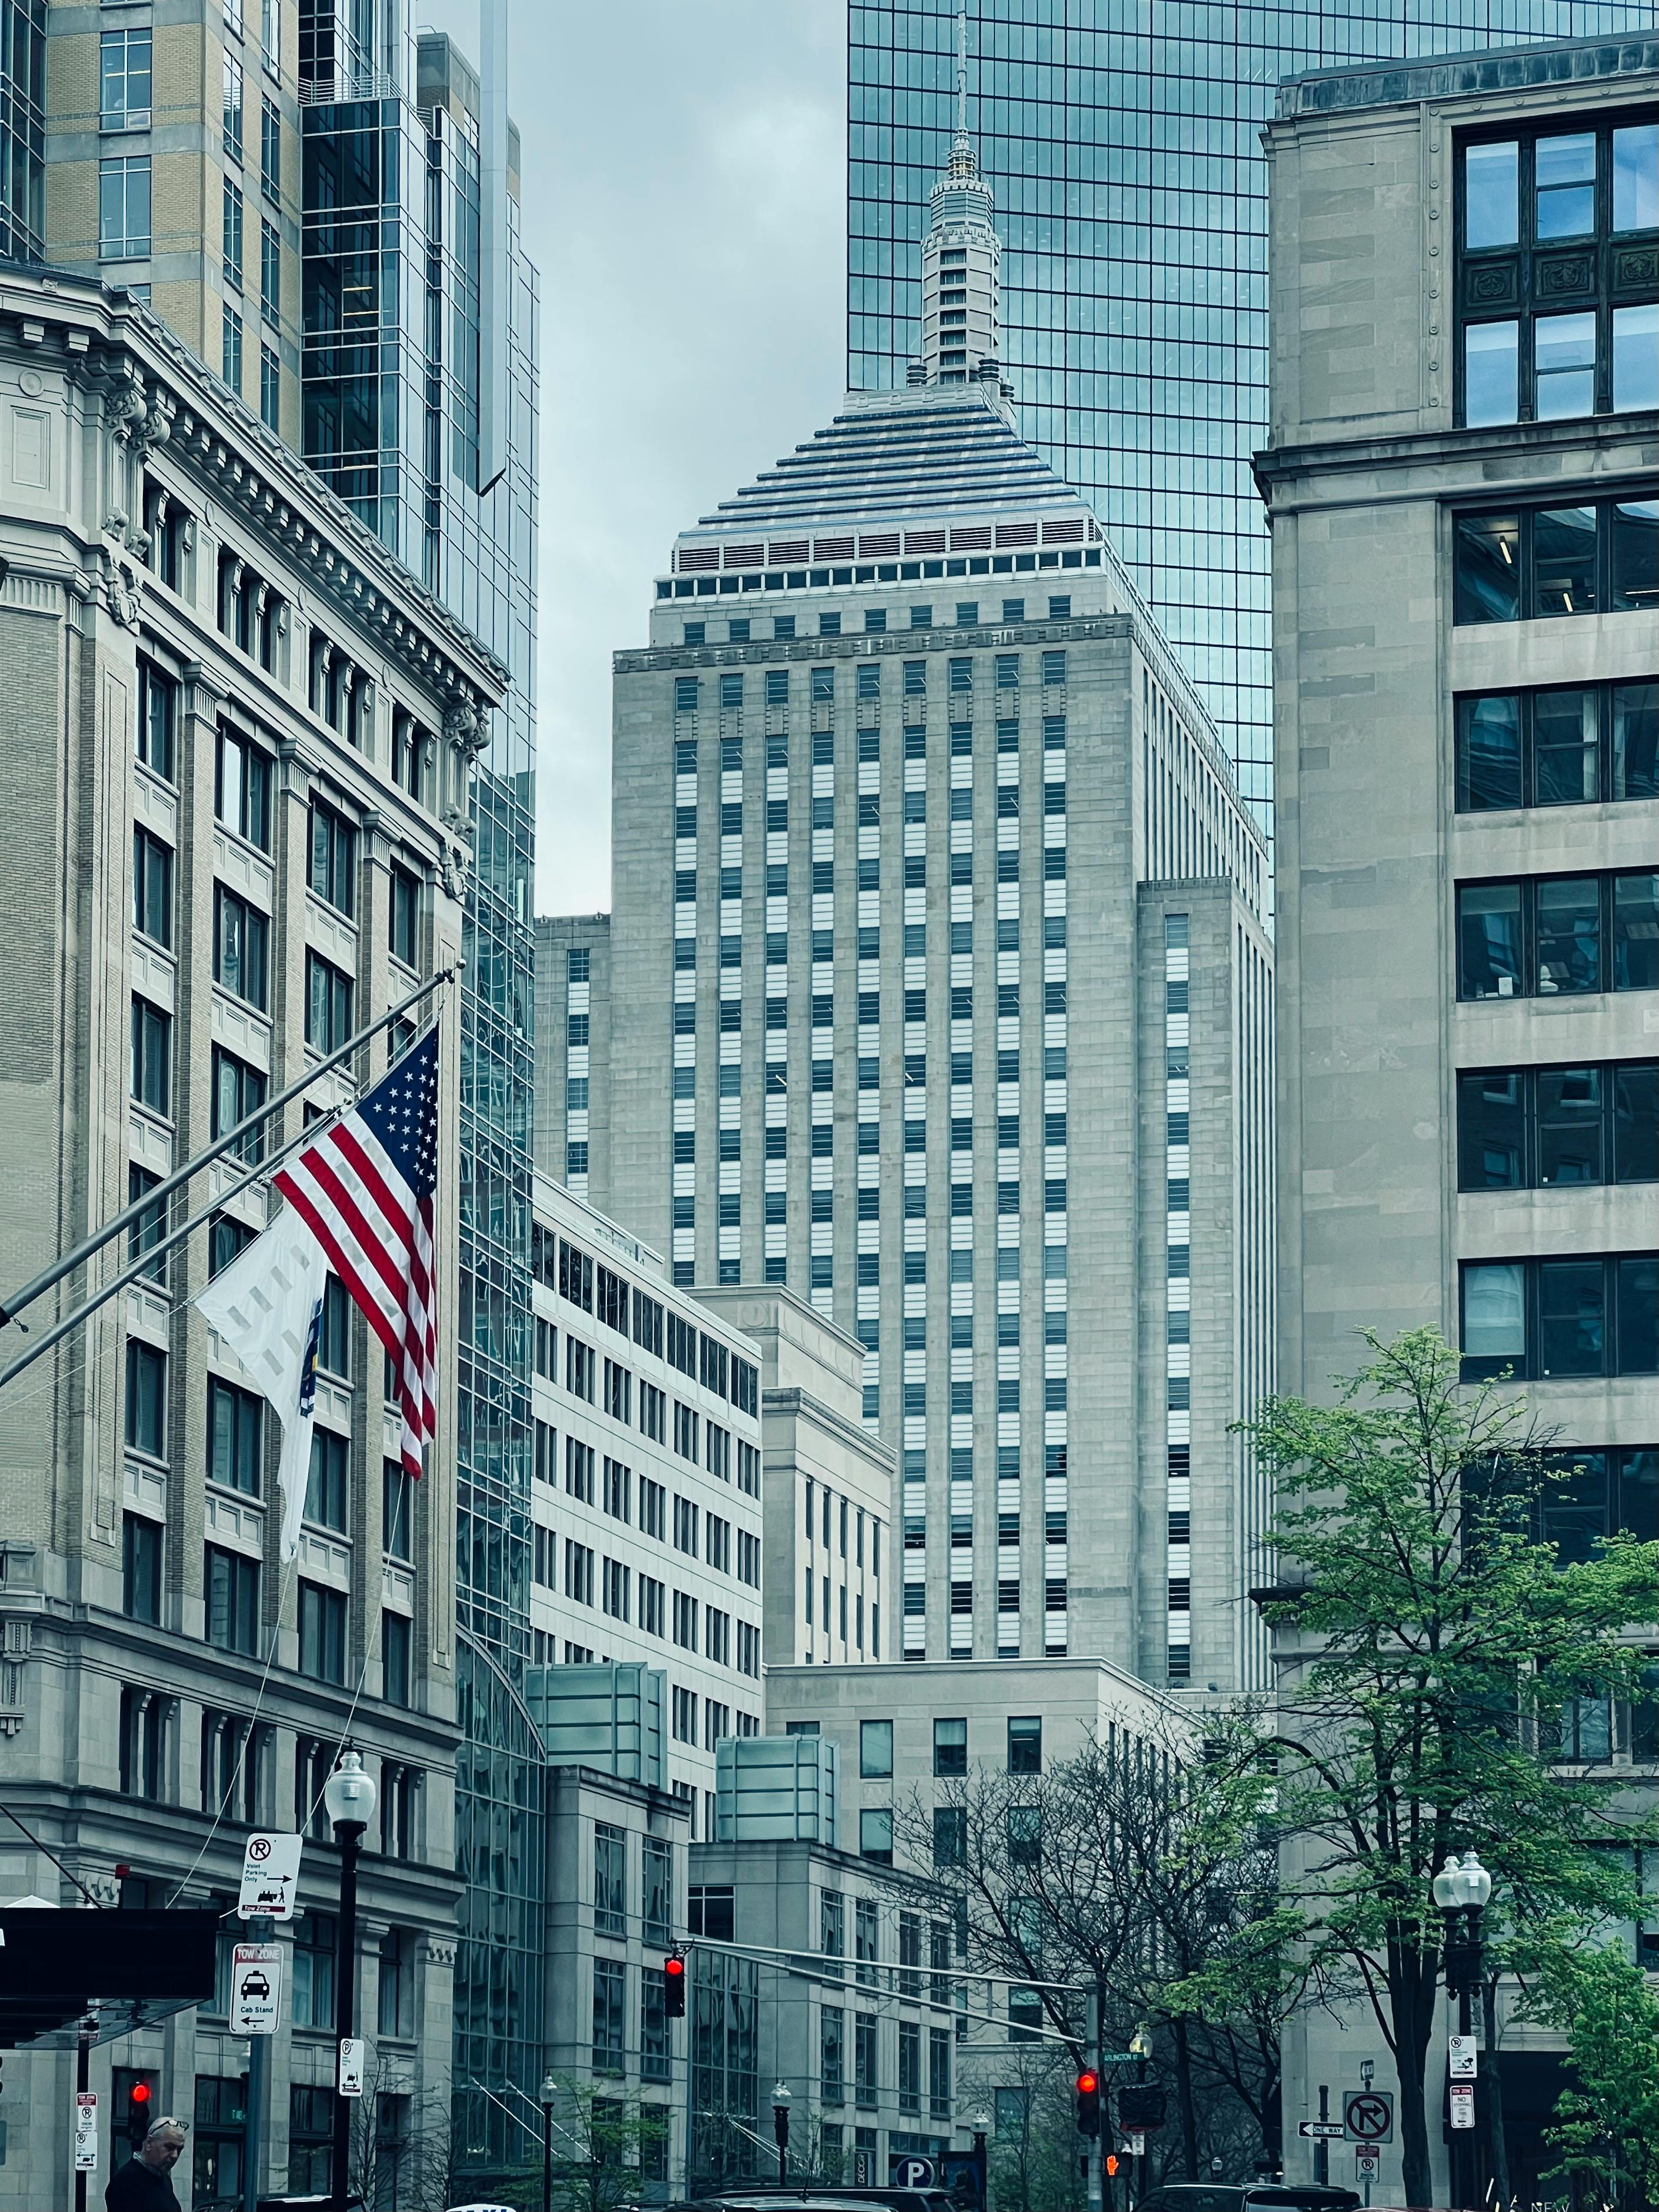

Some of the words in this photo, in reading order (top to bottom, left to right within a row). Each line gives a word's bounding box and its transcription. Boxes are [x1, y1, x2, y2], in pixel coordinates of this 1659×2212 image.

[237, 1949, 254, 1959] TOW
[258, 1949, 279, 1959] ZONE
[907, 2162, 924, 2187] P
